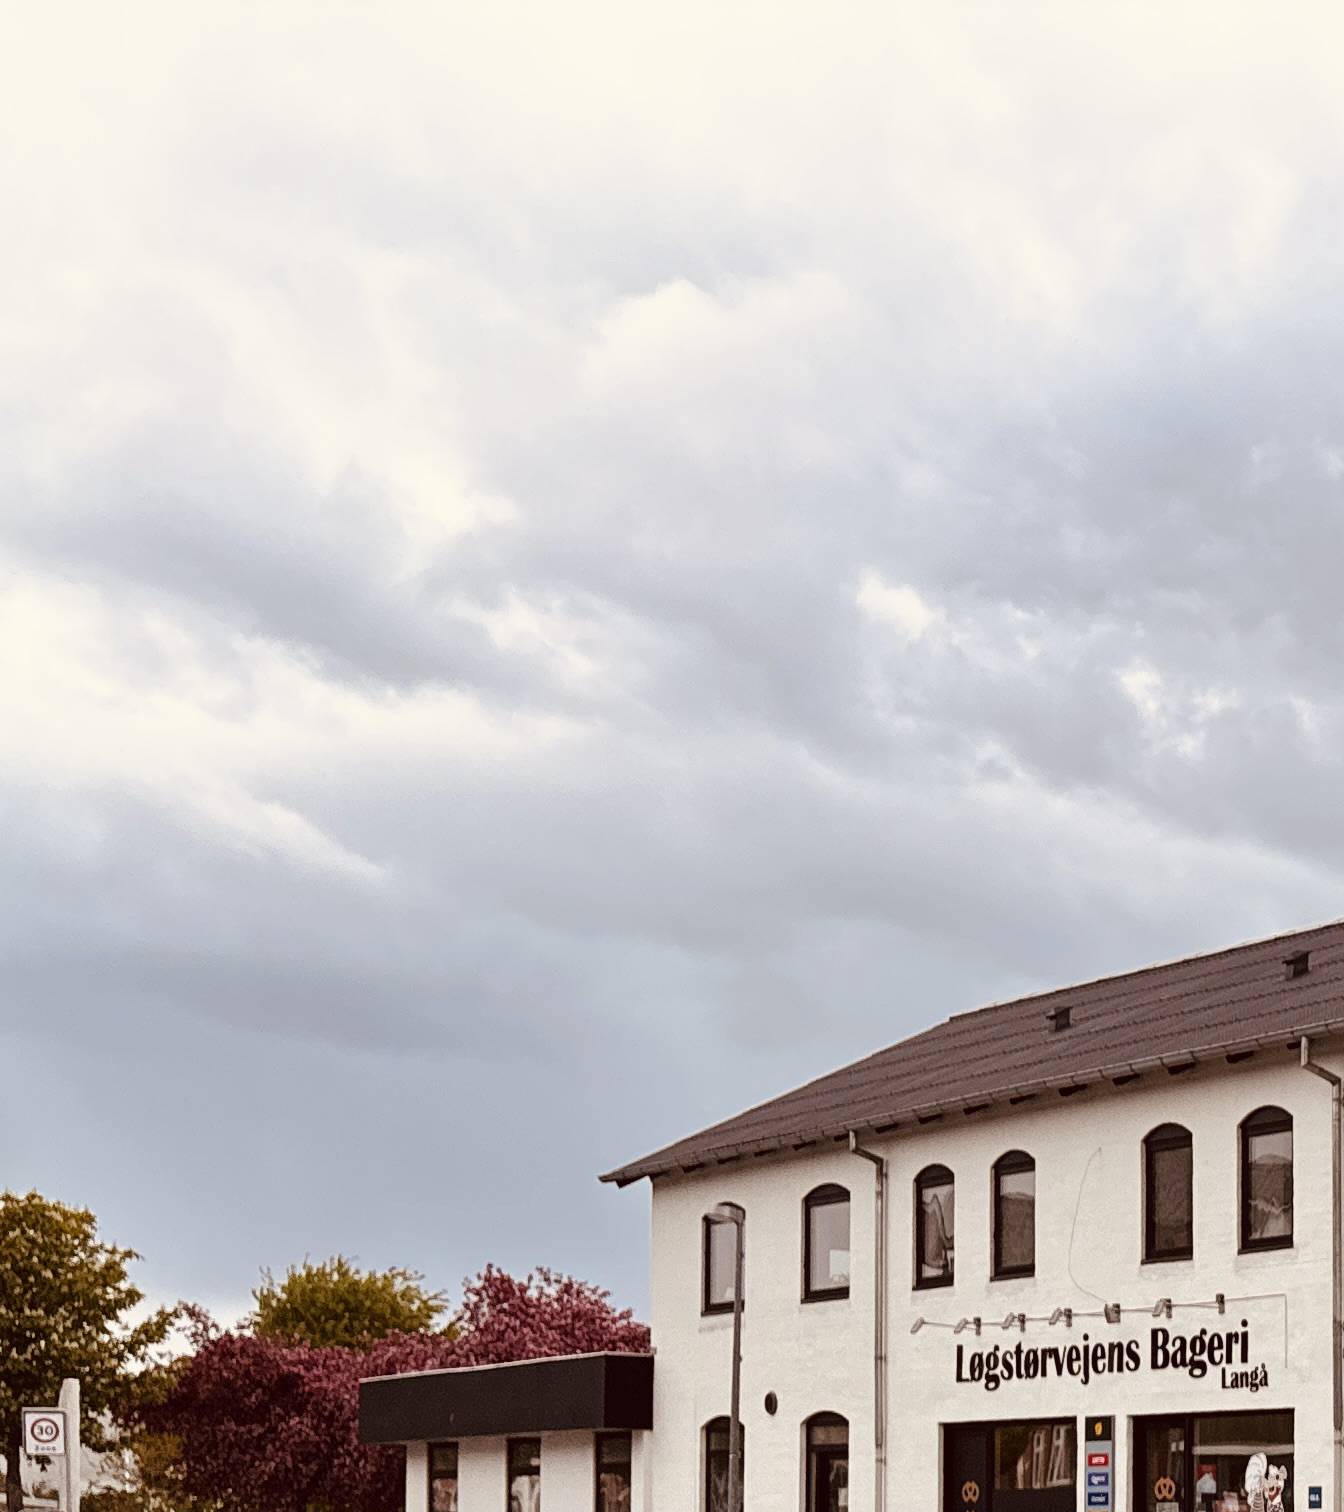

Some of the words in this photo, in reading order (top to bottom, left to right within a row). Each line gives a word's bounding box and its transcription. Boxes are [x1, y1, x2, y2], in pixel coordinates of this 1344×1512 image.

[956, 1333, 1141, 1391] Løgstørvejens
[1150, 1319, 1249, 1378] Bageri
[1221, 1363, 1268, 1392] Langå
